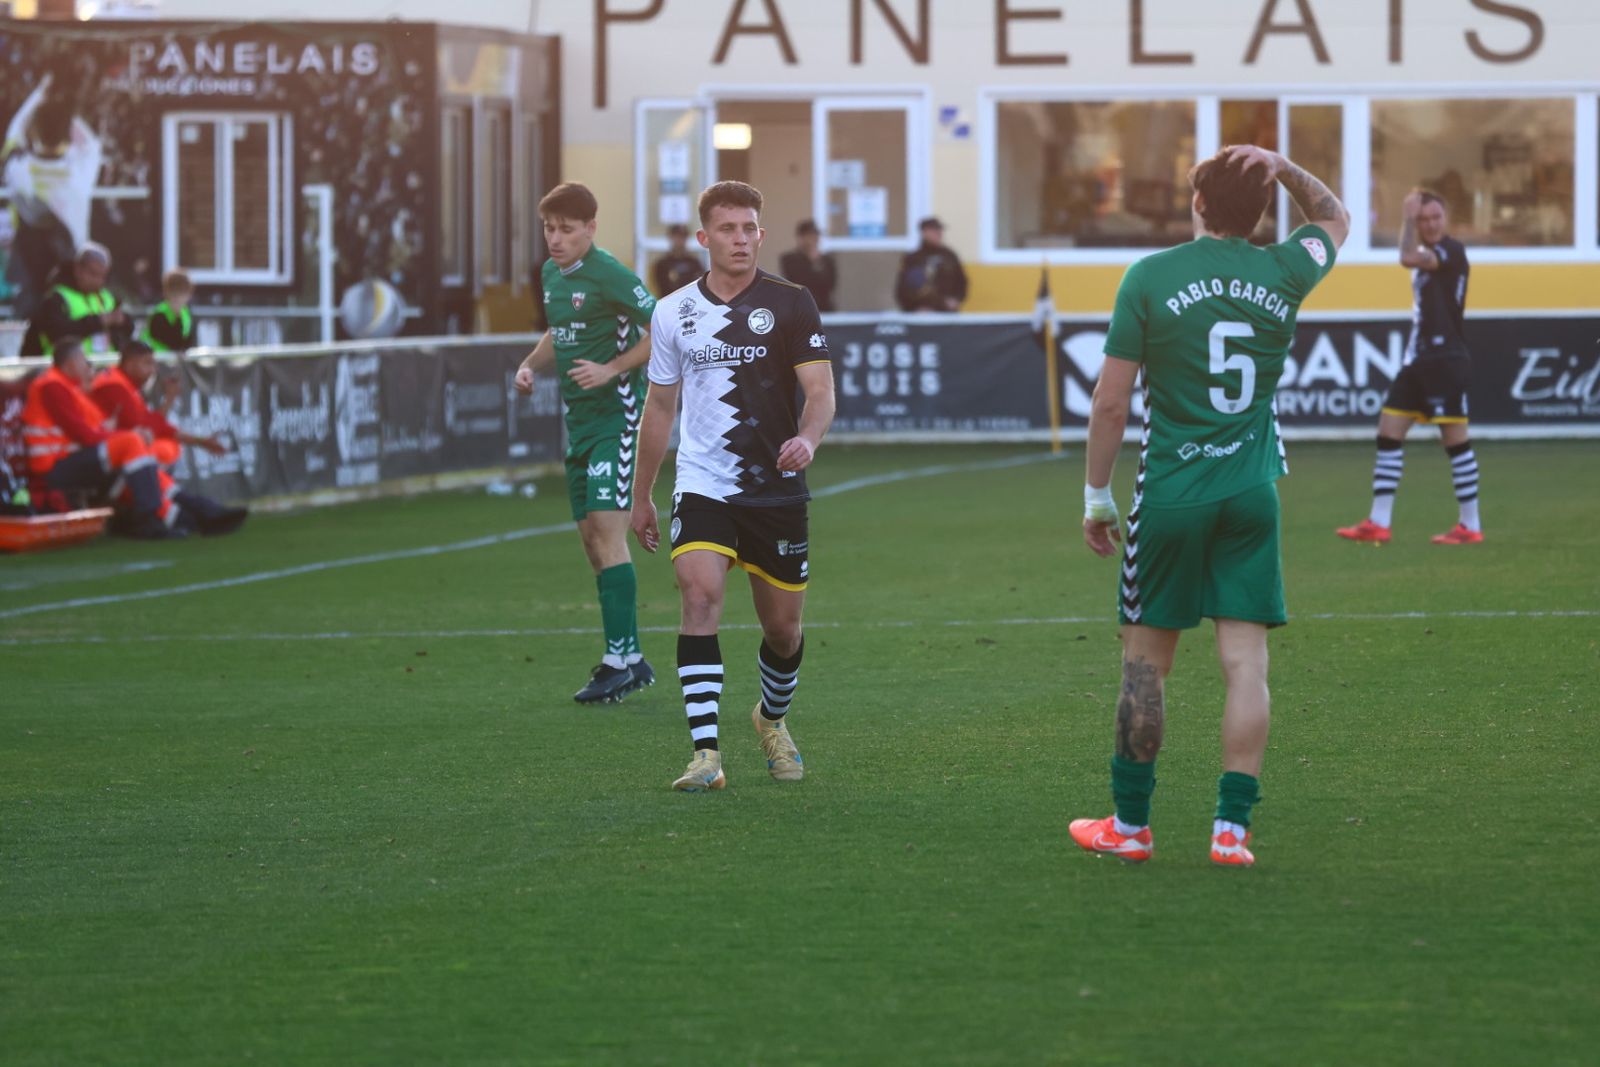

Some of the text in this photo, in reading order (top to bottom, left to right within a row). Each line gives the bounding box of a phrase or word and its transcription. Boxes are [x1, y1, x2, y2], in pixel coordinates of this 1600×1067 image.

[129, 41, 379, 84] PANELAIS
[594, 0, 1546, 109] PANELAIS
[1166, 278, 1289, 322] PABLO GARCIA
[688, 343, 768, 364] telefurgo
[842, 343, 940, 369] JOSE
[1208, 321, 1256, 415] 5
[842, 370, 941, 397] LUIS
